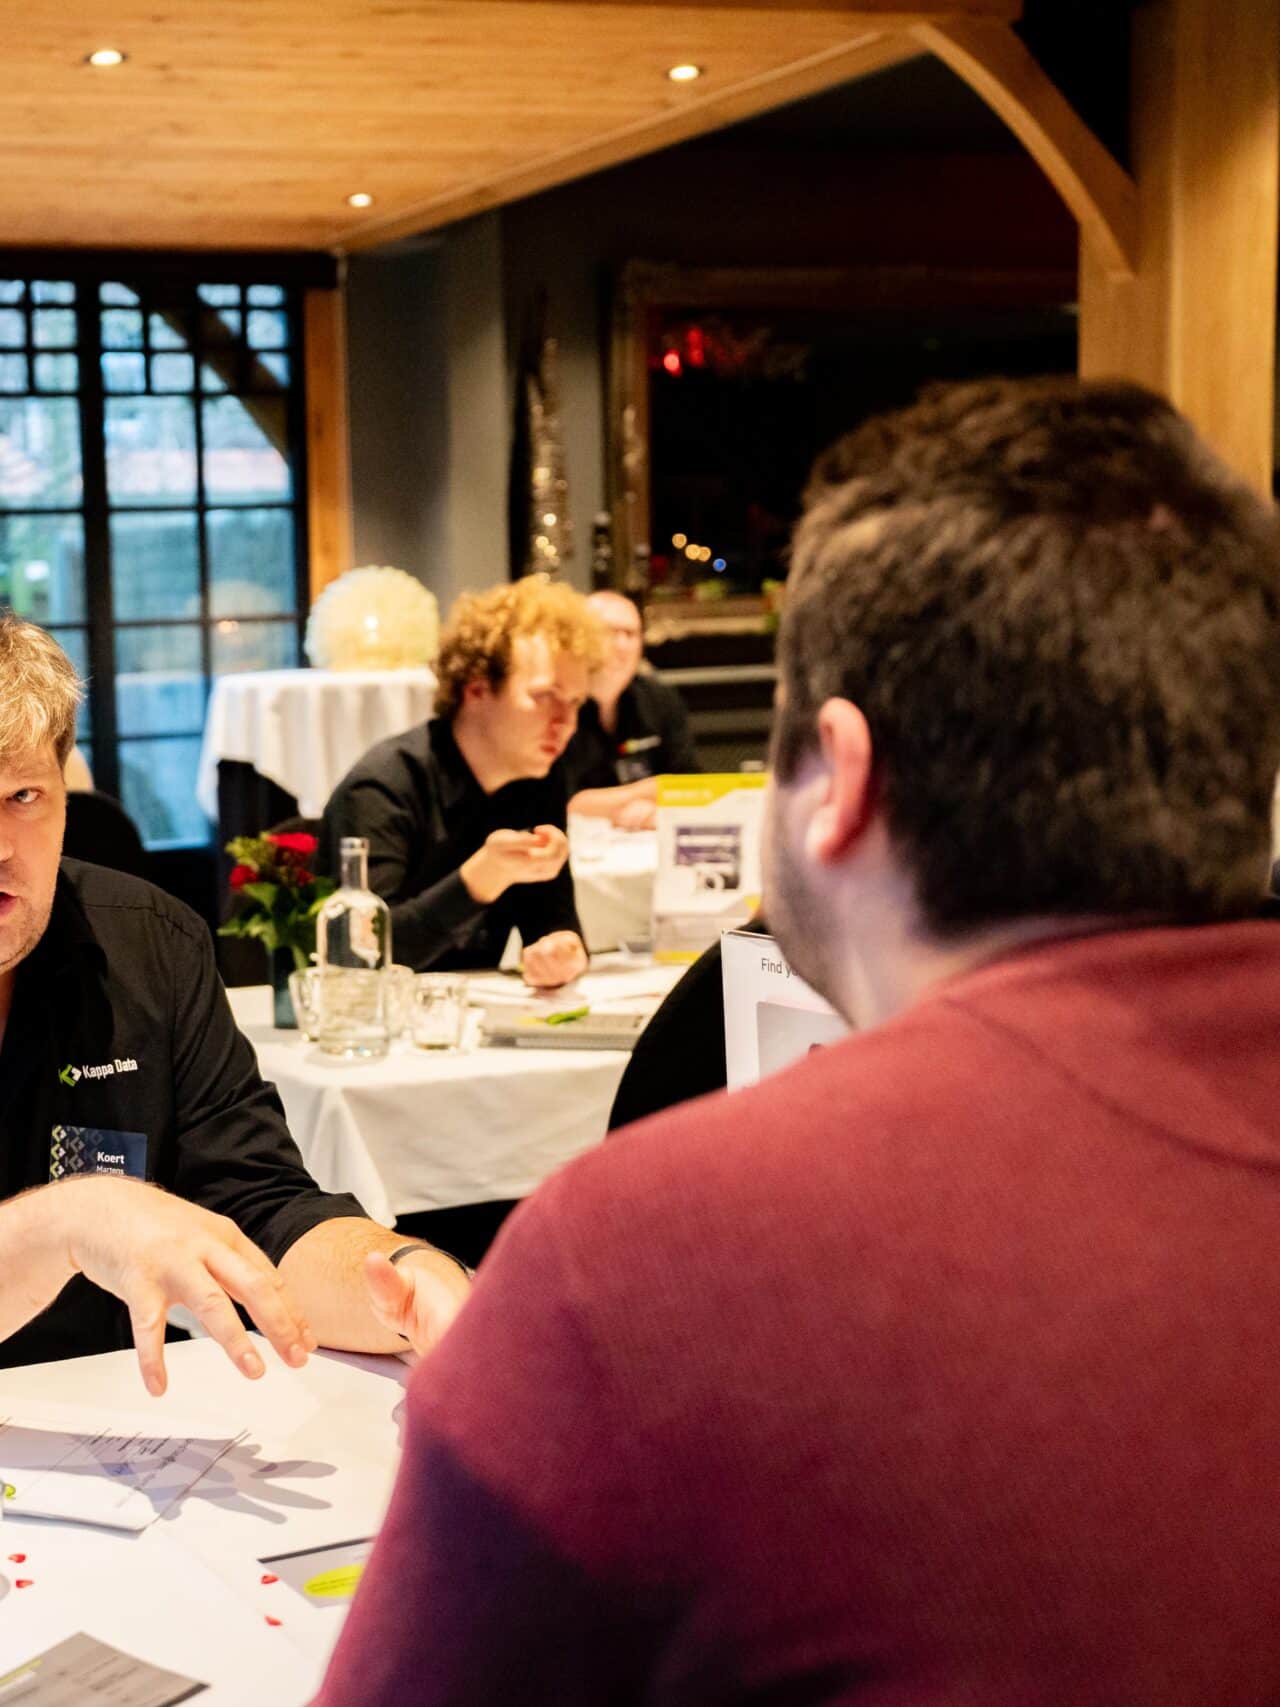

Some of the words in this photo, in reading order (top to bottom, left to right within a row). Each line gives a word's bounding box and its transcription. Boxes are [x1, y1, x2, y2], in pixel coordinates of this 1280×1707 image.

[761, 957, 783, 974] Find
[82, 1063, 115, 1081] Kappa
[113, 1058, 138, 1073] Data
[97, 1151, 125, 1164] Koert
